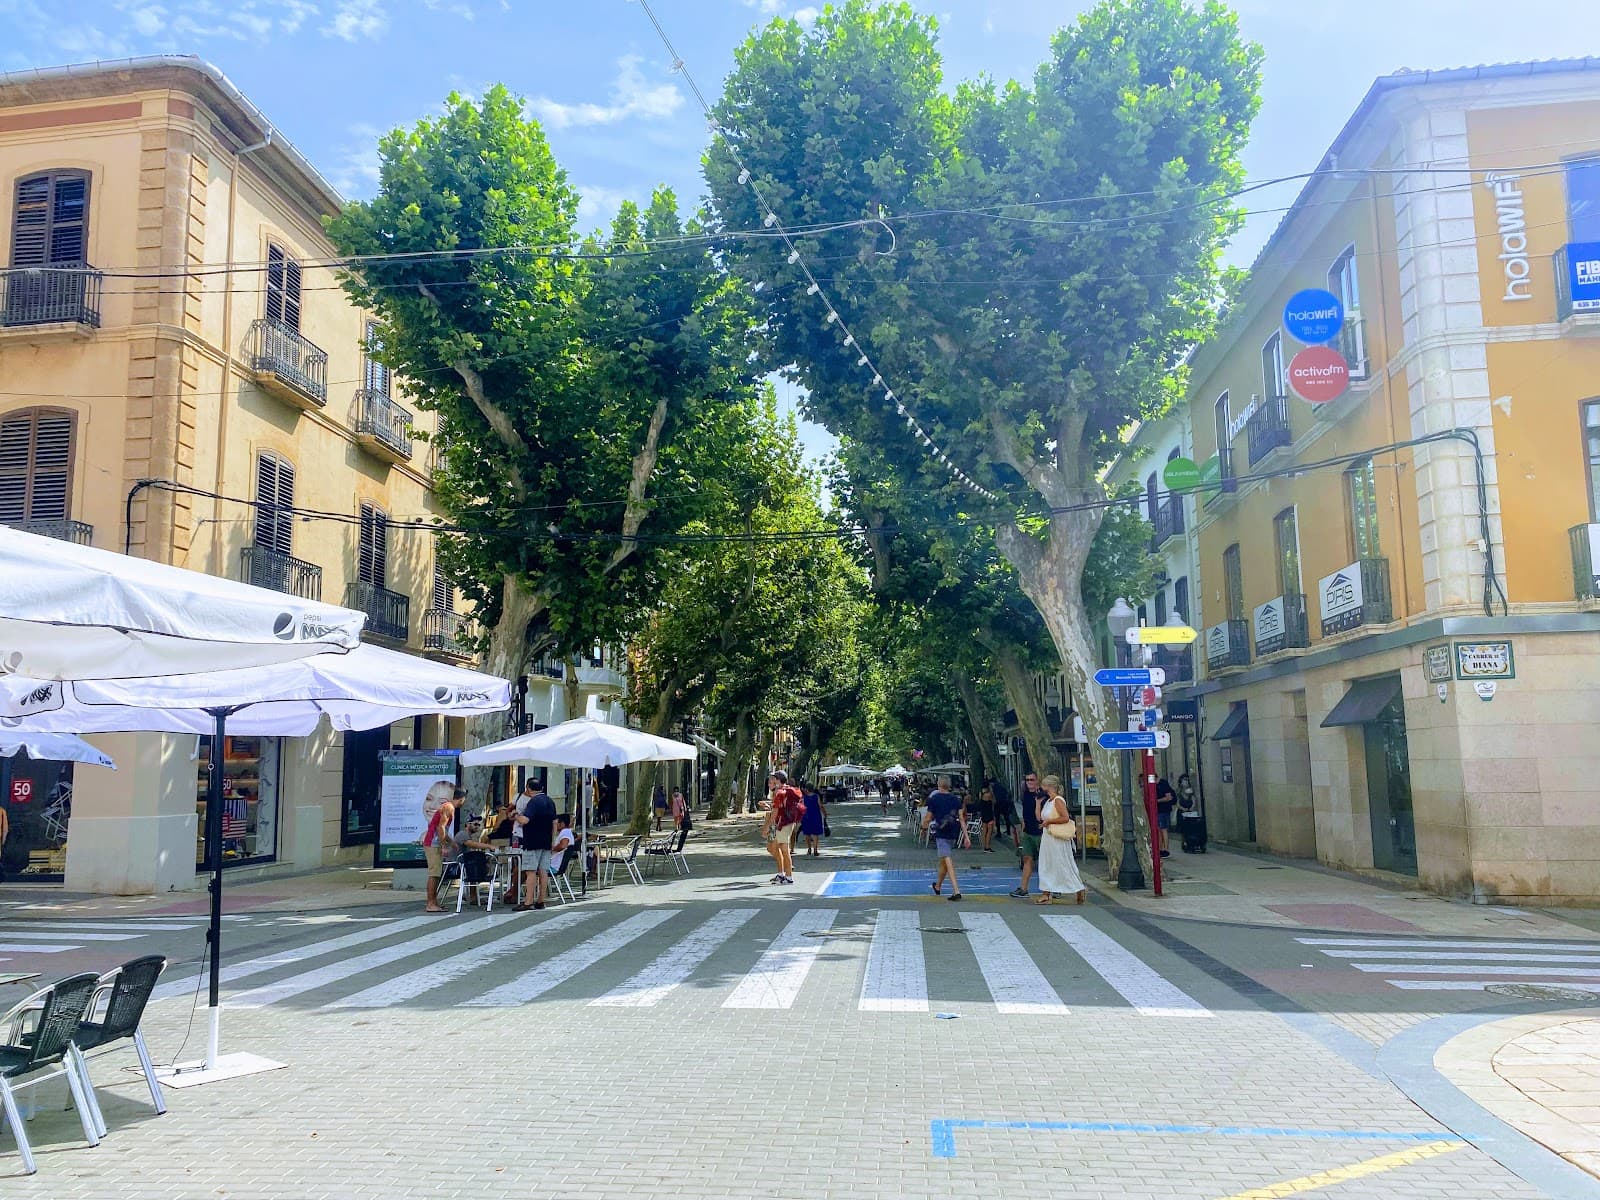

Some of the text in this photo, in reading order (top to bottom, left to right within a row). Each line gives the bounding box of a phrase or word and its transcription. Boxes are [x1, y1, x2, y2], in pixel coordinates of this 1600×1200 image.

[1294, 365, 1344, 376] activafm
[303, 614, 322, 622] pepsi
[301, 623, 350, 640] MAX
[13, 783, 31, 796] 50
